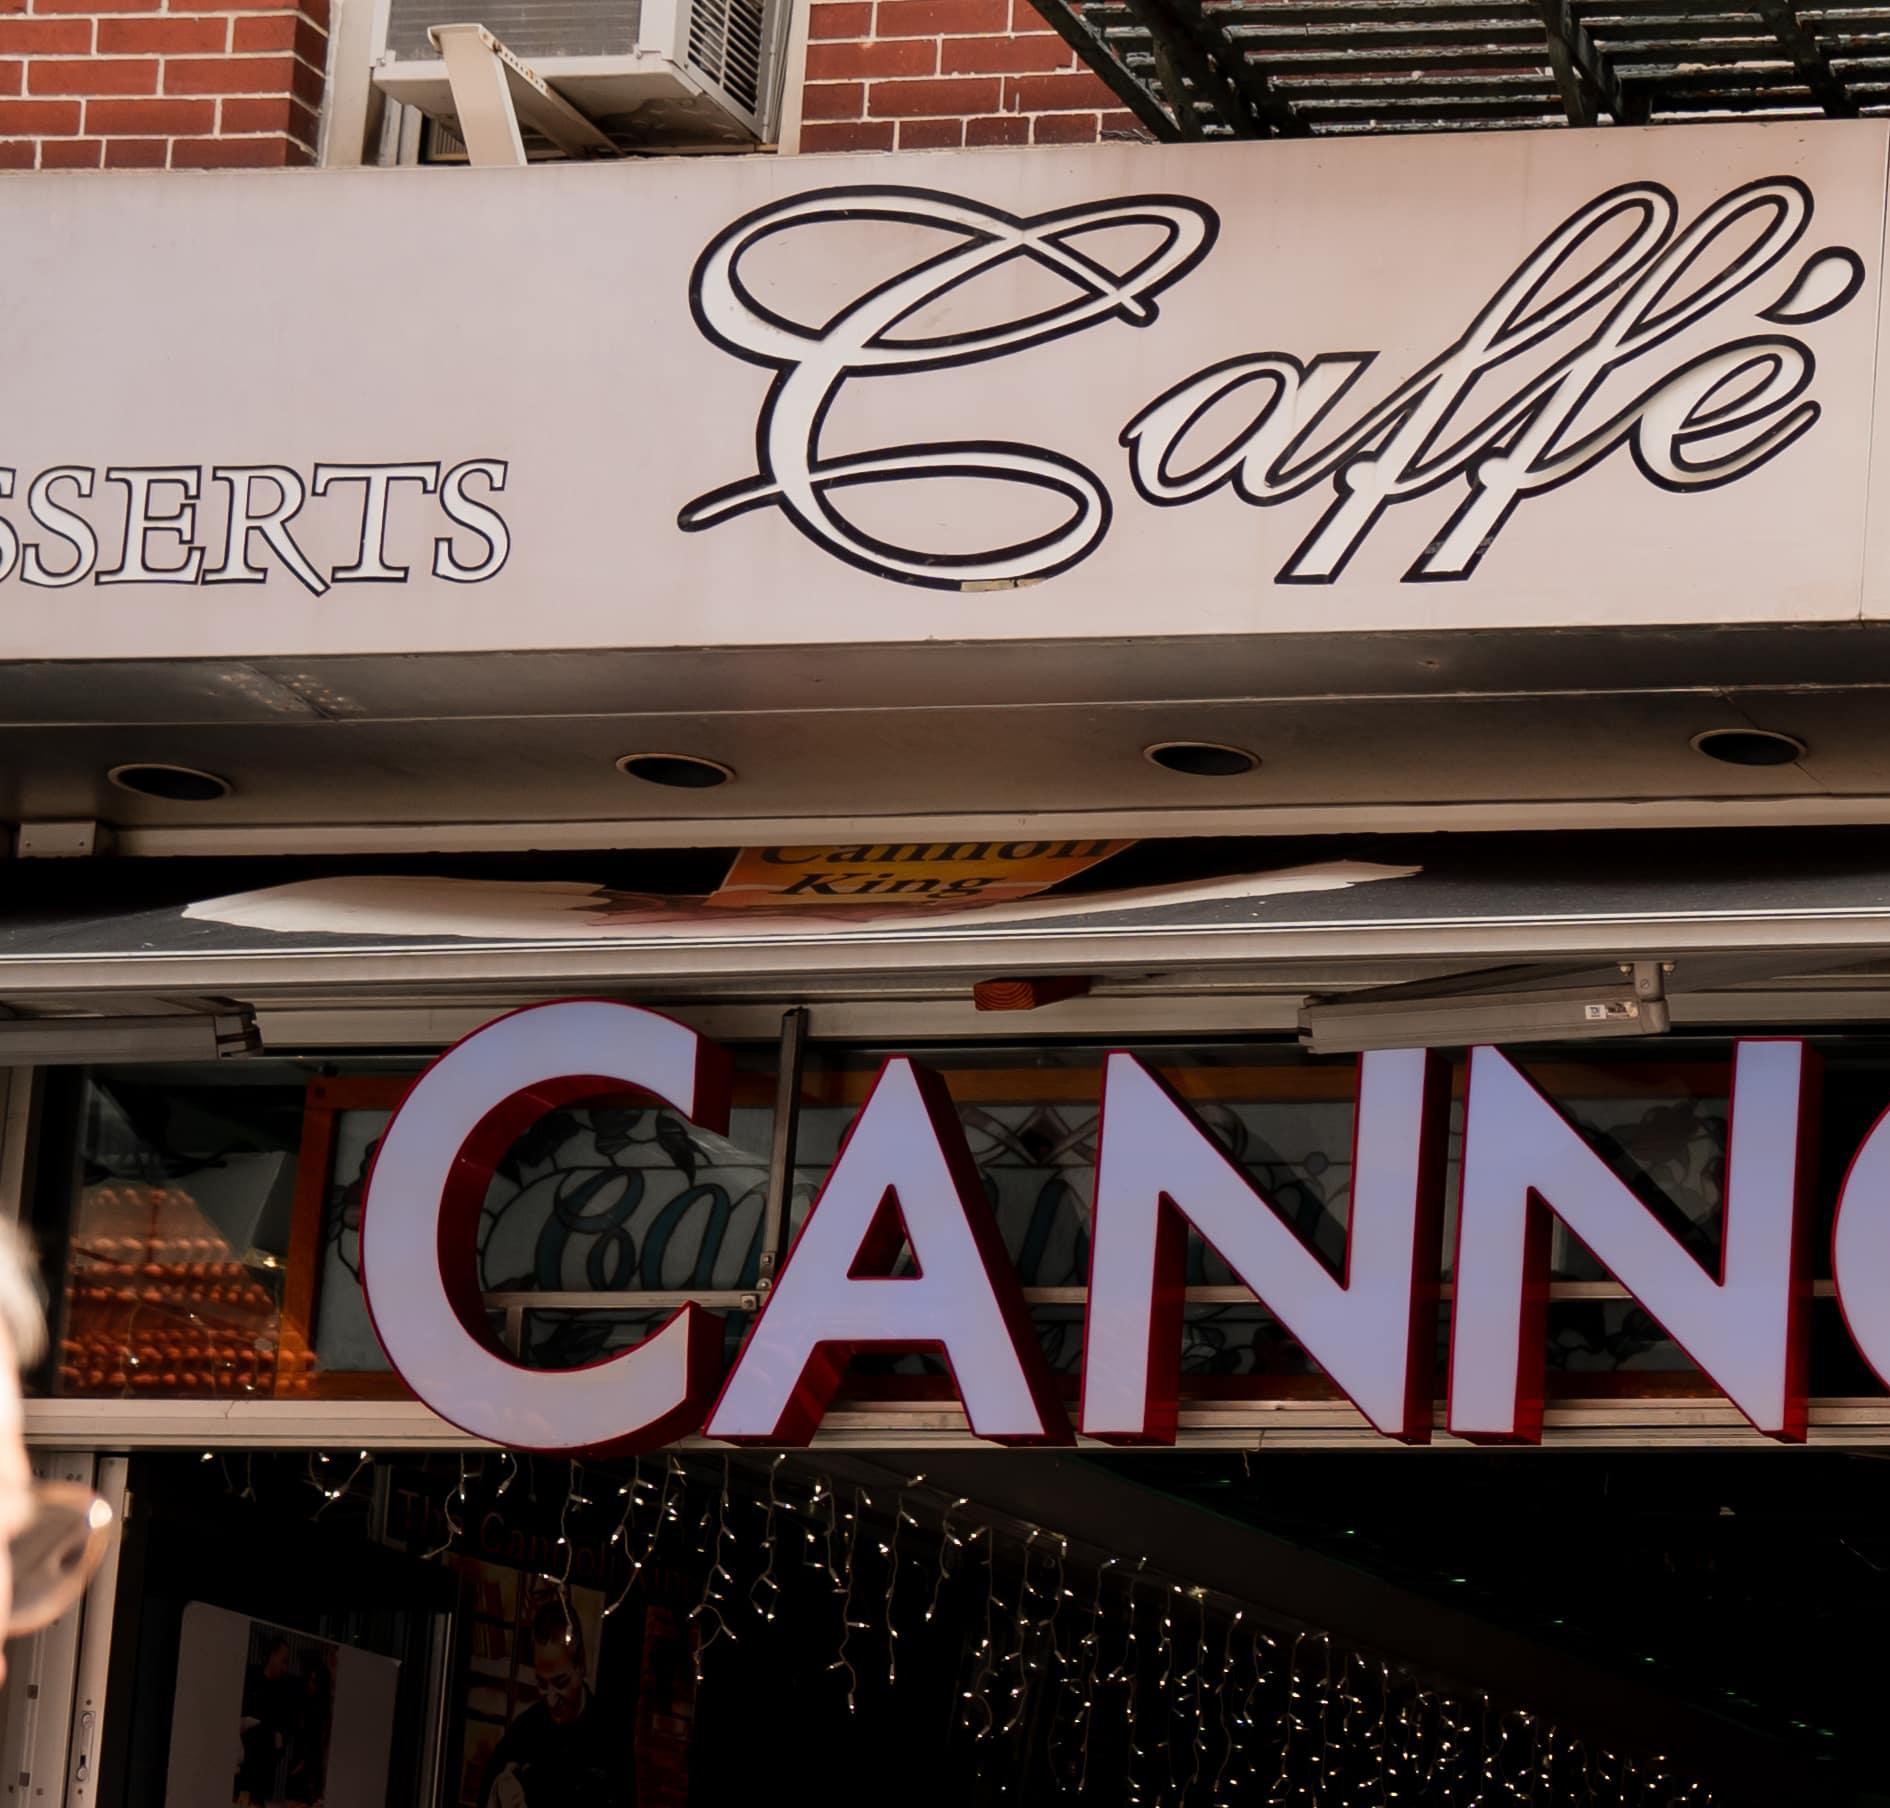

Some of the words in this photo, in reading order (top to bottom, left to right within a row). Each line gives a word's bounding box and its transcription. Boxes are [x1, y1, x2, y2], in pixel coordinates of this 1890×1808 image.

[675, 174, 1866, 592] Caffé
[0, 457, 511, 598] SERTS
[768, 872, 1006, 899] King
